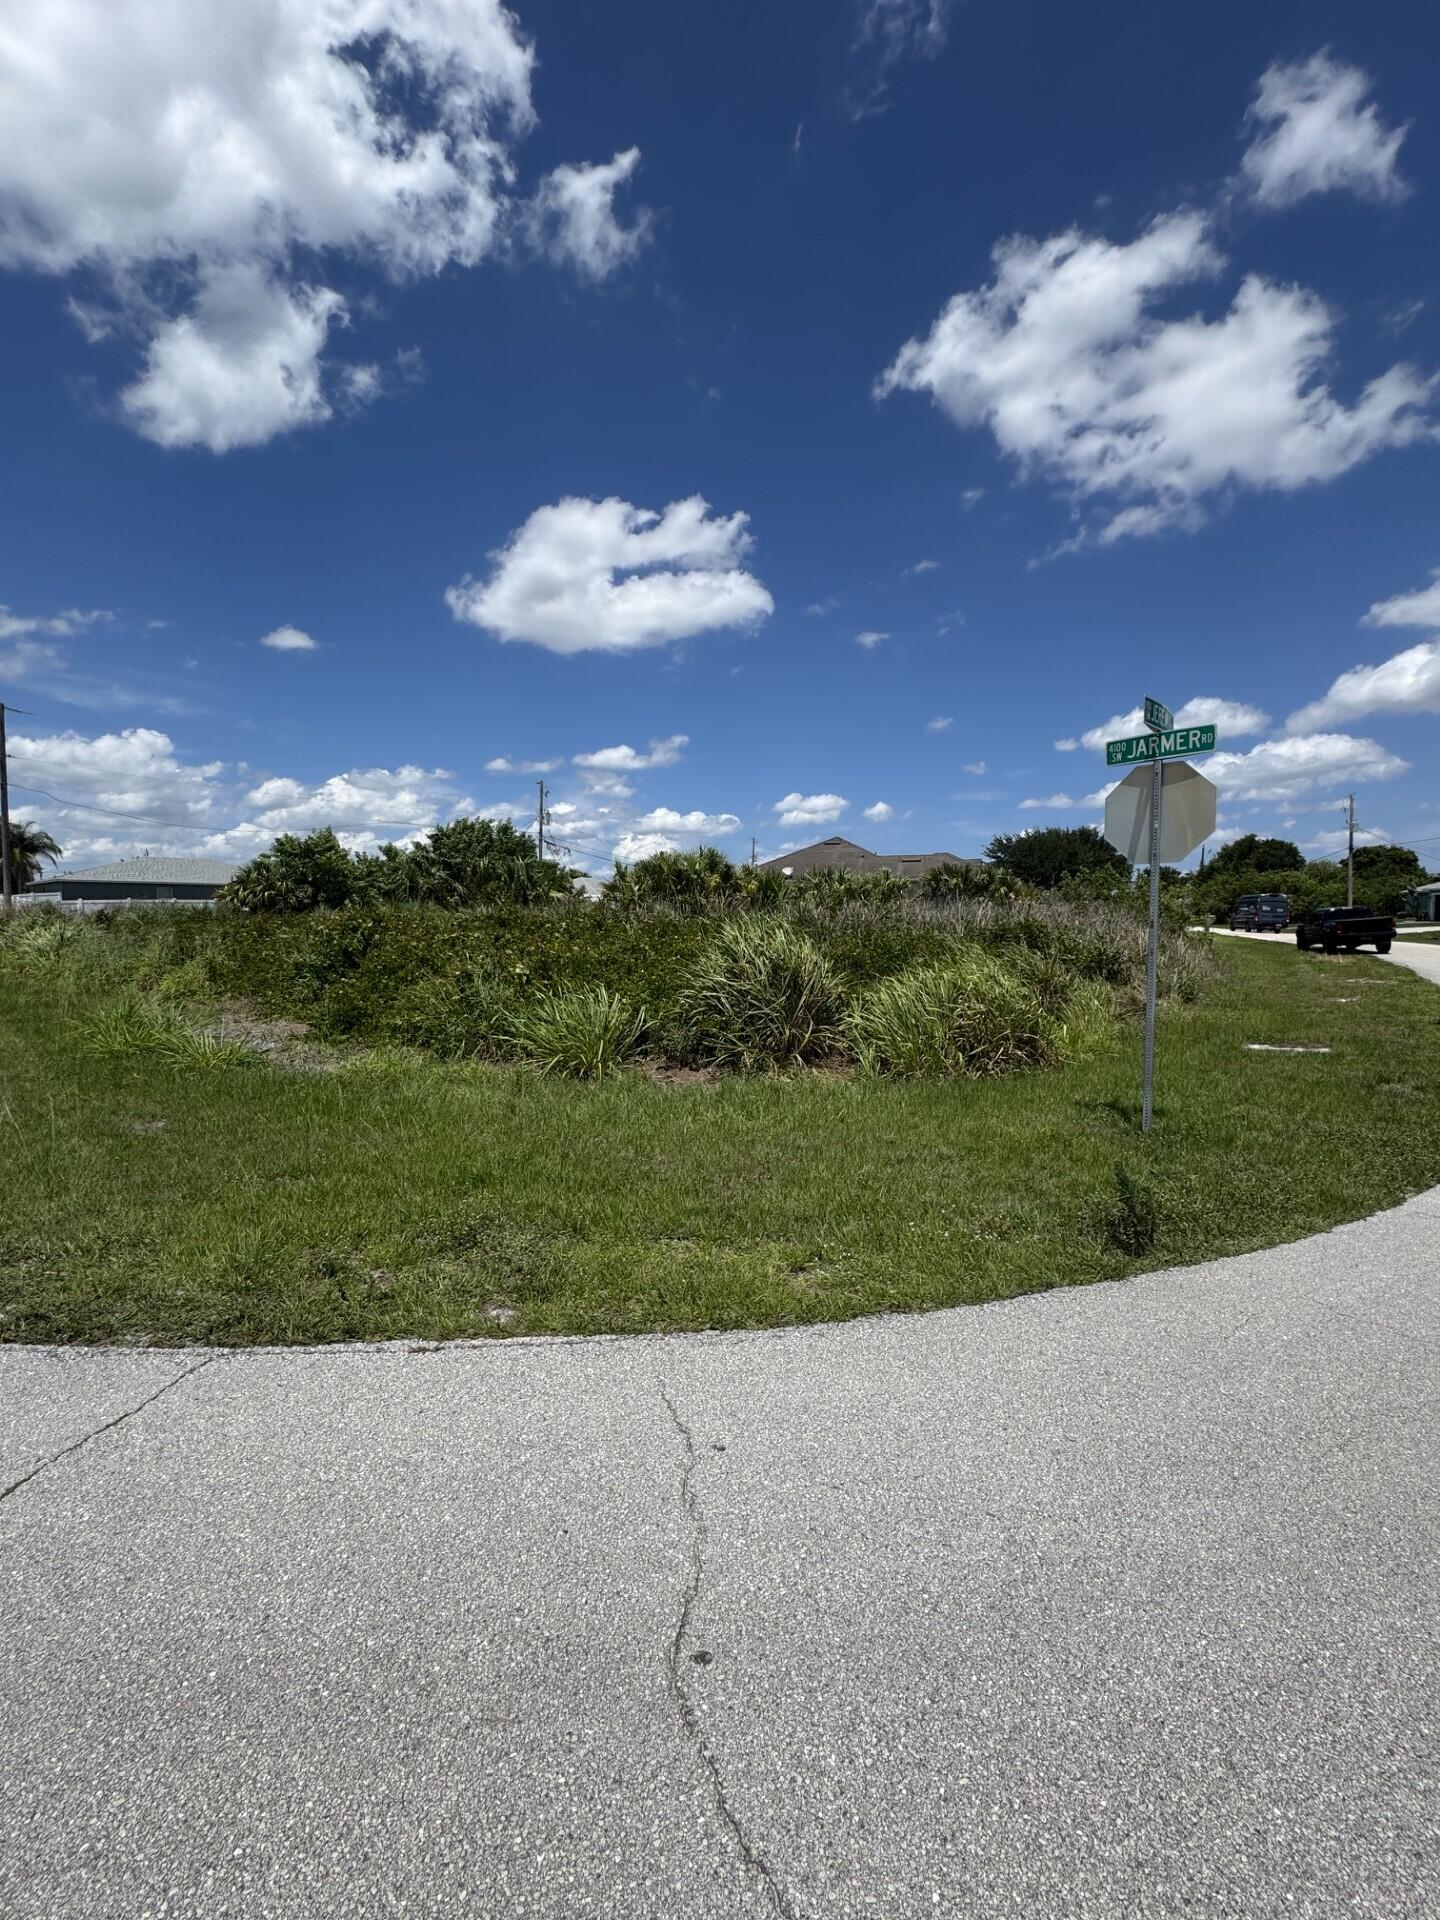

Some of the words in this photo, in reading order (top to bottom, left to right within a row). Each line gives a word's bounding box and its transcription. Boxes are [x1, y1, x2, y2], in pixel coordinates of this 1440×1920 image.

[1109, 742, 1126, 753] 4100
[1127, 730, 1201, 759] JARMER
[1201, 733, 1213, 744] RD
[1112, 751, 1122, 762] SW
